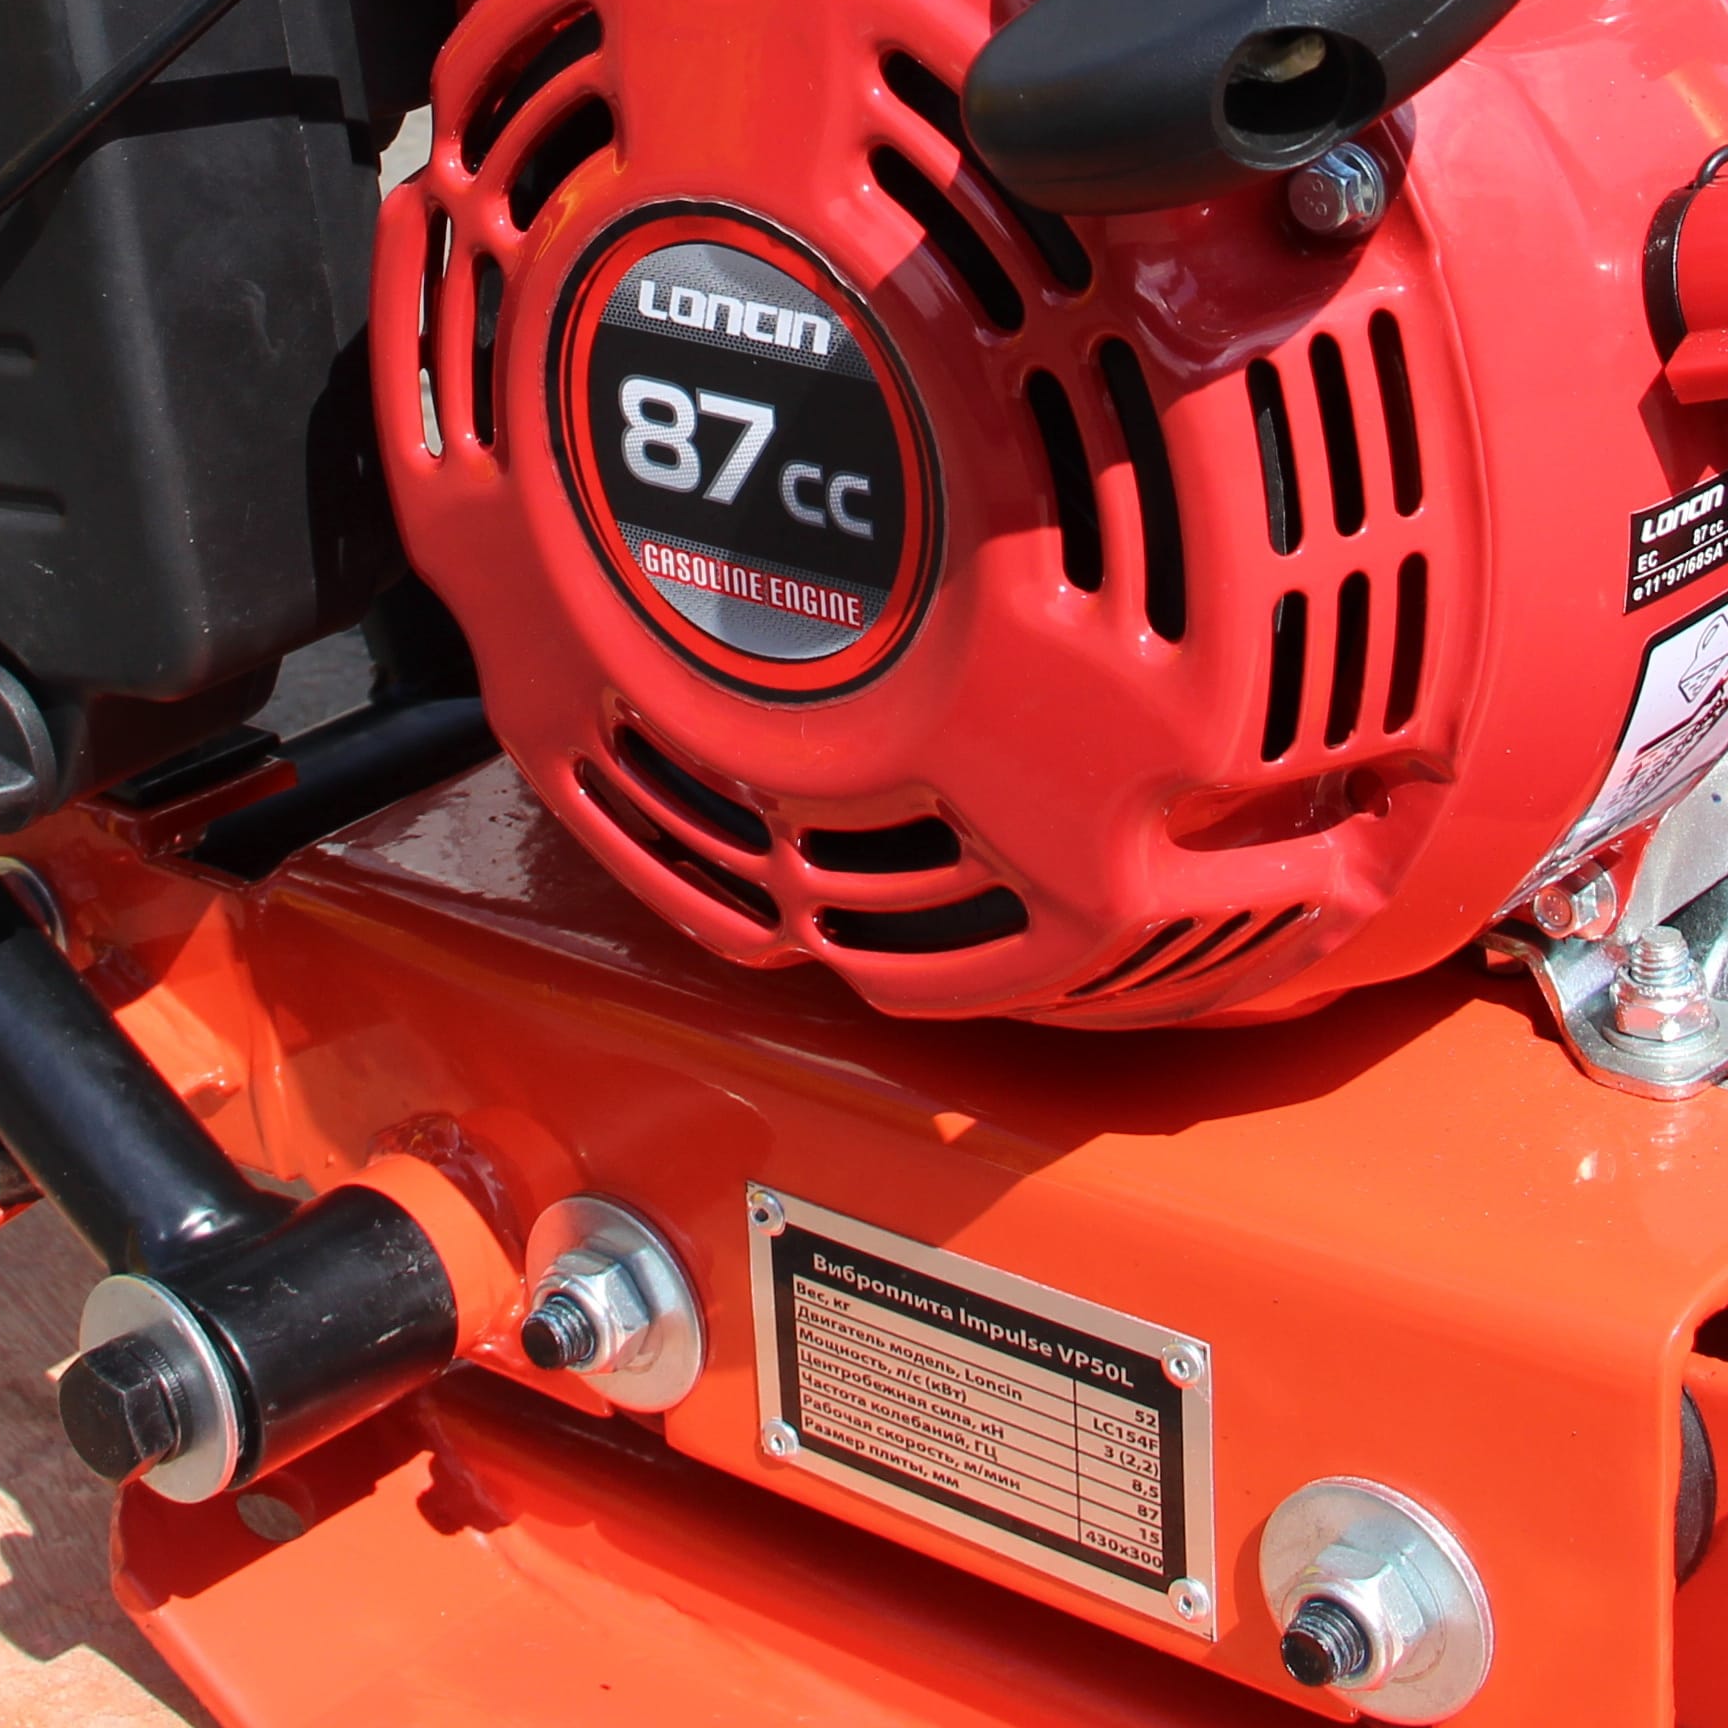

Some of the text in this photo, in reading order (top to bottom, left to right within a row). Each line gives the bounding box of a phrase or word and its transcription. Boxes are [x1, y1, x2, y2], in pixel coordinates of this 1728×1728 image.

[618, 373, 776, 506] 87
[1692, 523, 1707, 545] 87
[643, 543, 861, 627] GASOLINE ENGINE
[1637, 550, 1659, 573] EC
[795, 1280, 851, 1312] Вес, кг
[813, 1252, 1135, 1389] Виброплита Impulse VP50L
[797, 1305, 1023, 1402] Двигатель модель, Loncin
[799, 1327, 892, 1375] Мощность,
[925, 1375, 968, 1404] (кВт)
[800, 1349, 1005, 1440] Центробежная сила, кН
[801, 1371, 999, 1462] Частота колебаний, ГЦ
[1135, 1409, 1157, 1428] 52
[802, 1394, 1021, 1491] Рабочая скорость, м/мин
[804, 1415, 961, 1489] Размер плиты, мм
[1093, 1417, 1159, 1452] LC154F
[1104, 1444, 1159, 1477] 3 (2,2)
[1132, 1479, 1160, 1499] 8,5
[1137, 1504, 1159, 1522] 87
[1139, 1527, 1160, 1545] 15
